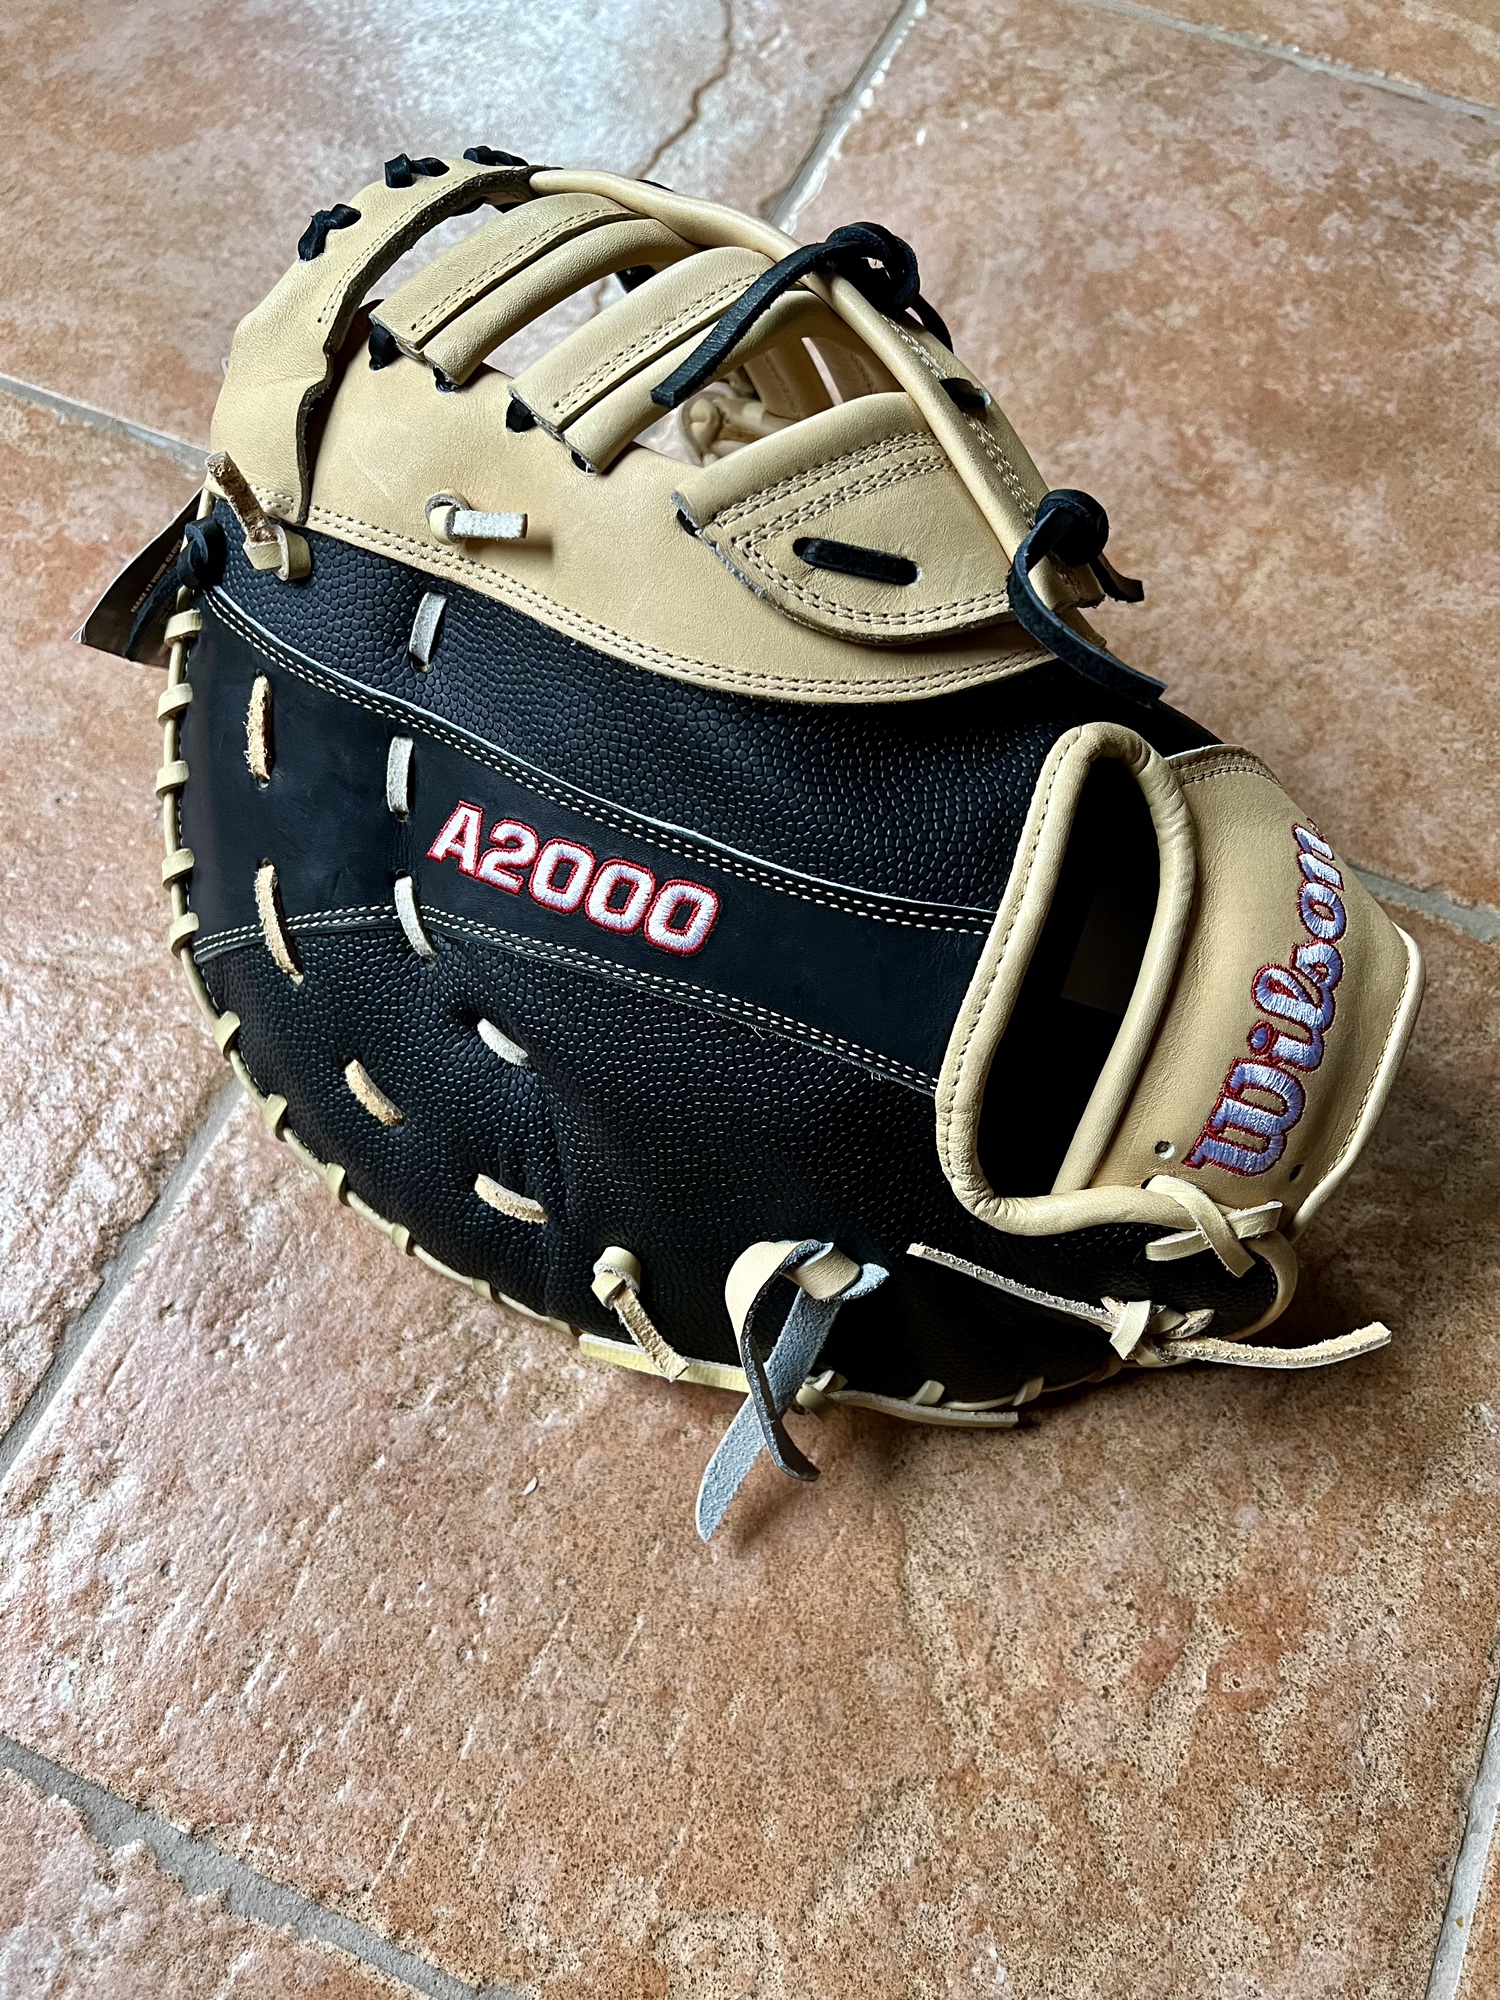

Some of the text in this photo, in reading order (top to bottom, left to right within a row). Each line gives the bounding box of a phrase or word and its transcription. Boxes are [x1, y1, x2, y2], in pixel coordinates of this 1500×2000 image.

[130, 592, 147, 613] MAKE
[150, 563, 168, 583] YOUR
[427, 799, 721, 958] A2000
[1181, 823, 1347, 1178] Wilson
